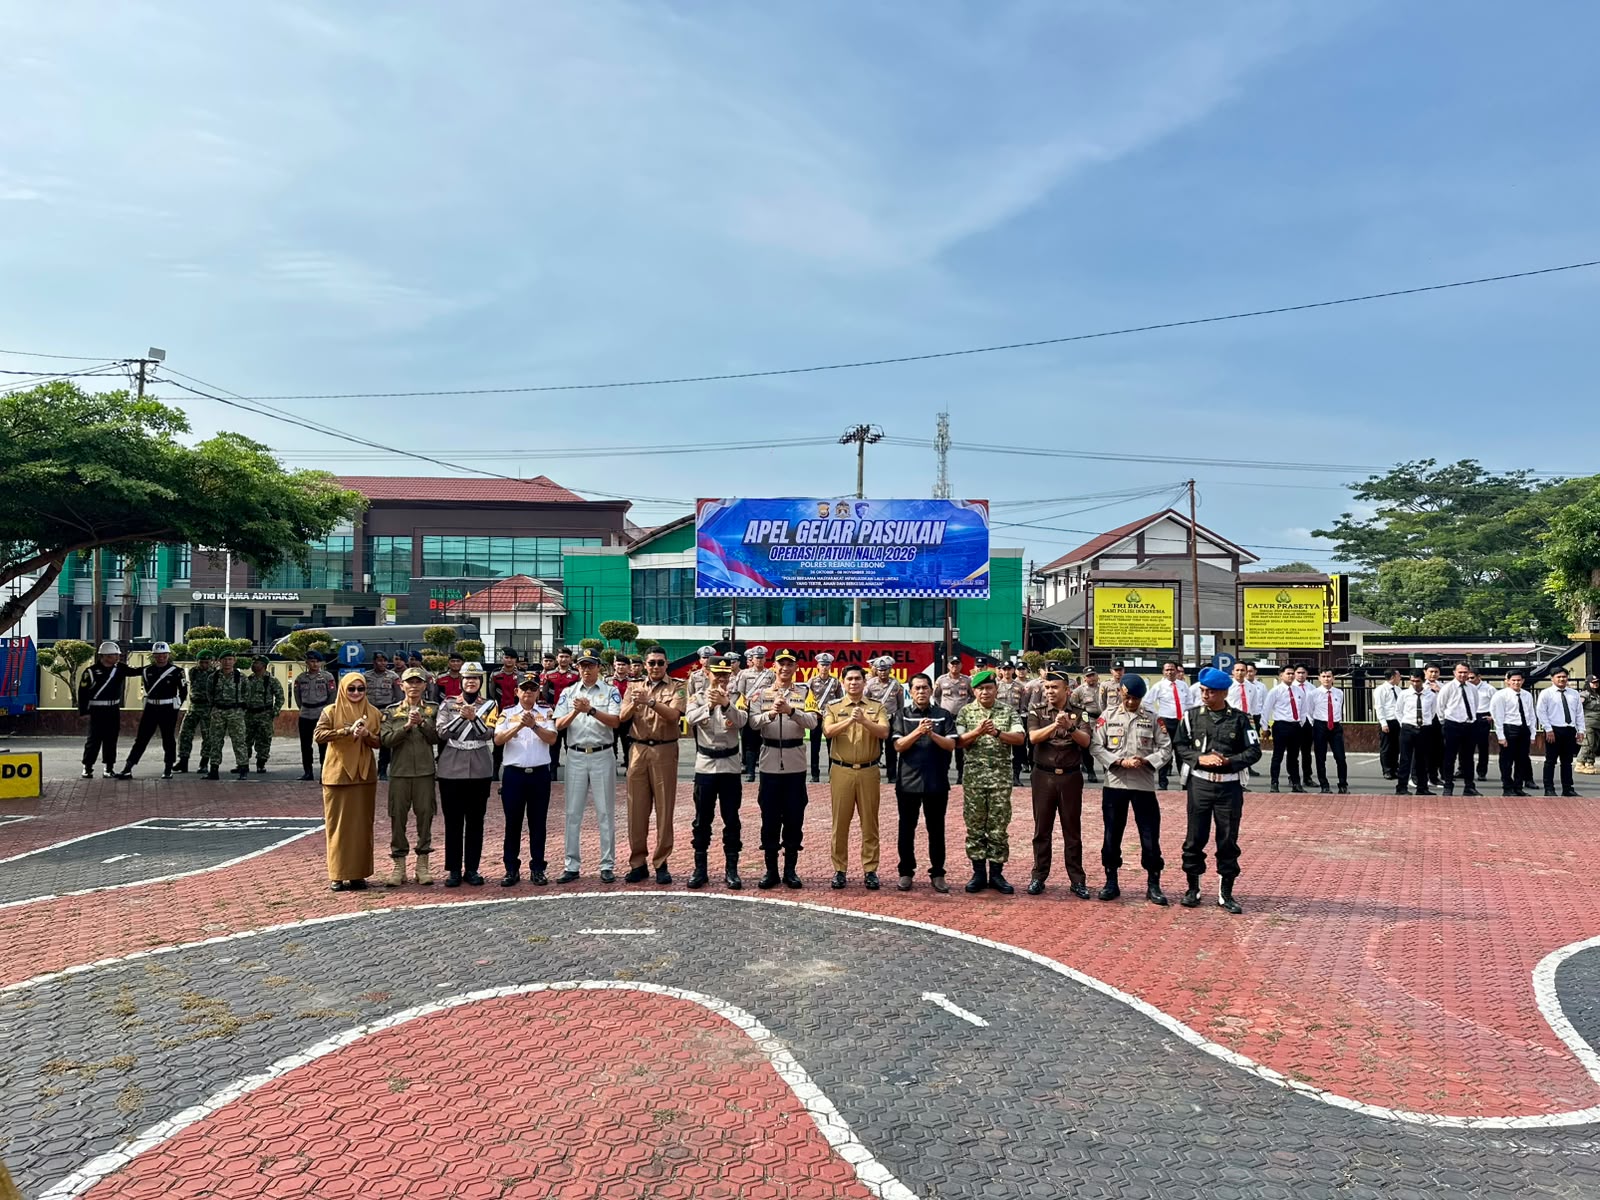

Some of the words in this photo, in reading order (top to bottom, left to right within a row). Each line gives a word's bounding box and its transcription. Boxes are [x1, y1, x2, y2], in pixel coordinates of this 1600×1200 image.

[743, 519, 791, 544] APEL
[795, 519, 855, 544] GELAR
[857, 519, 947, 544] PASUKAN
[769, 545, 816, 561] OPERASI
[817, 545, 852, 561] PATUH
[854, 545, 882, 561] NALA
[884, 545, 916, 561] 2026
[346, 645, 360, 662] P
[1219, 656, 1230, 672] P
[2, 763, 32, 778] DO
